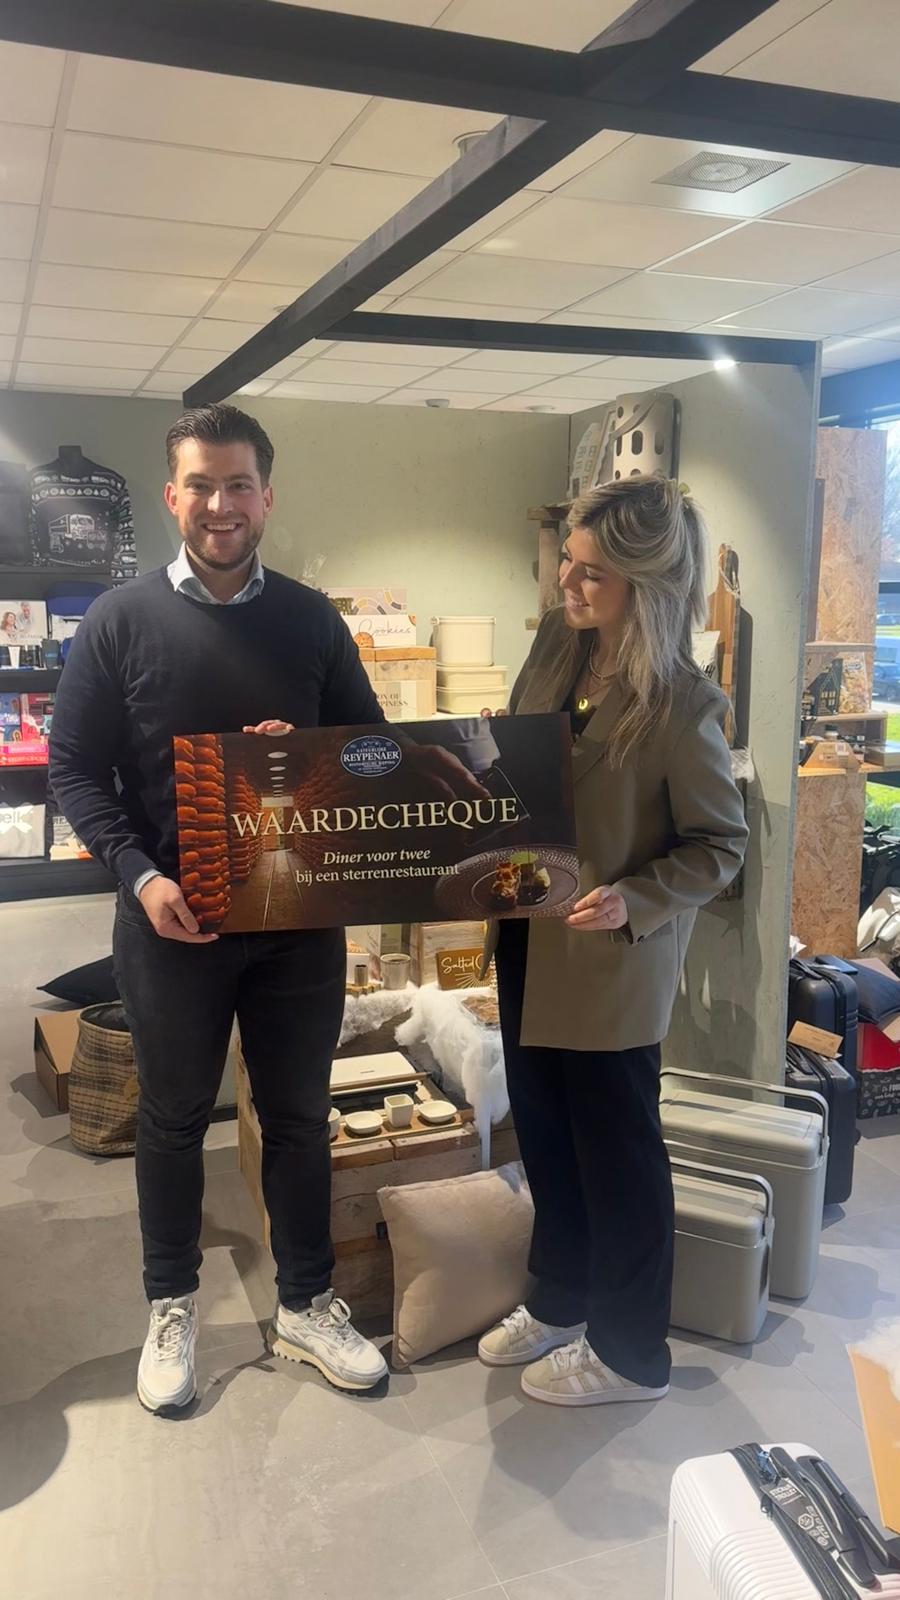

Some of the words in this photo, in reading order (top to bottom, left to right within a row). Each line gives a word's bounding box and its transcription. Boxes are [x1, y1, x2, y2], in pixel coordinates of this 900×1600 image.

[359, 619, 411, 637] Cookies
[343, 751, 400, 762] REYPENAER
[231, 798, 520, 838] WAARDECHEQUE
[323, 851, 363, 865] Diner
[366, 852, 397, 862] voor
[400, 849, 431, 861] twee
[296, 870, 313, 886] bij
[316, 870, 339, 882] een
[342, 863, 460, 881] sterrenrestaurant
[441, 955, 475, 974] Salted
